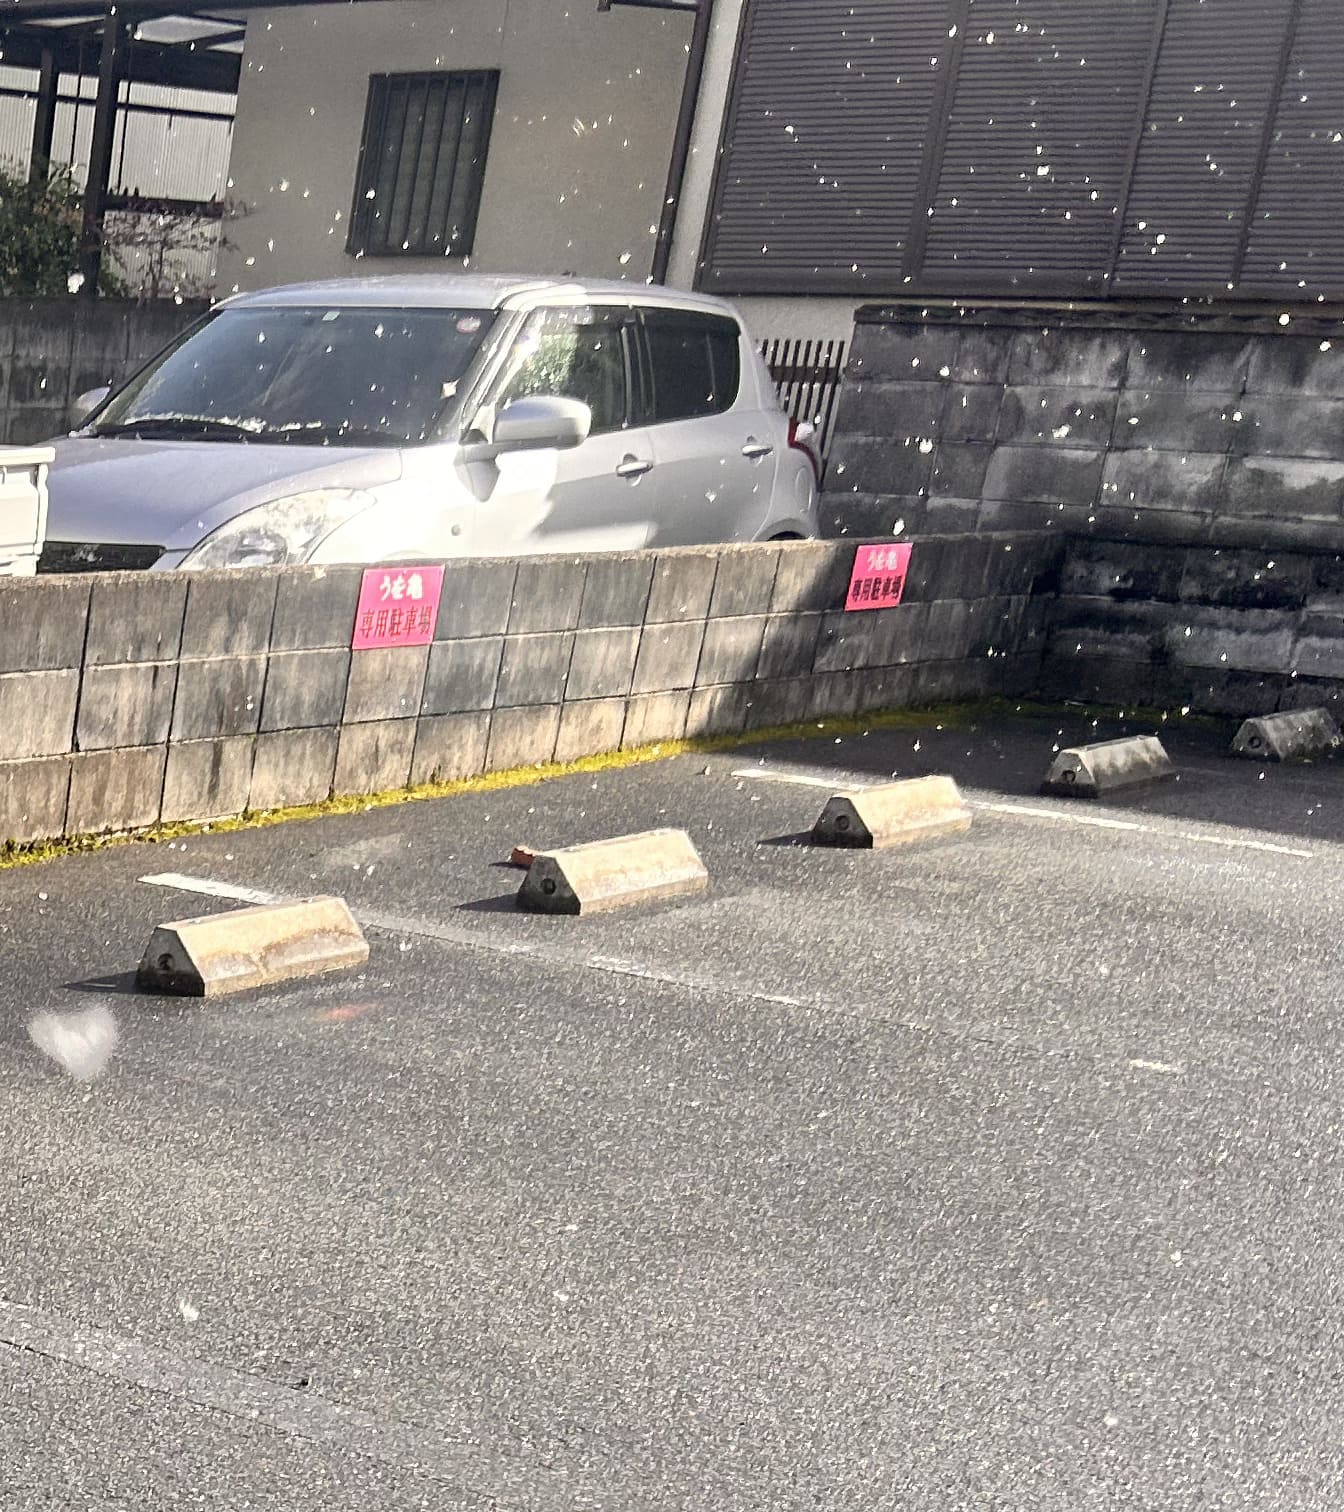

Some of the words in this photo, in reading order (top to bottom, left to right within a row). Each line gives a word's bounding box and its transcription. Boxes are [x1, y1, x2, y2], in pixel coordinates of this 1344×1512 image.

[379, 573, 423, 601] うを亀
[360, 605, 432, 638] 専用駐車場
